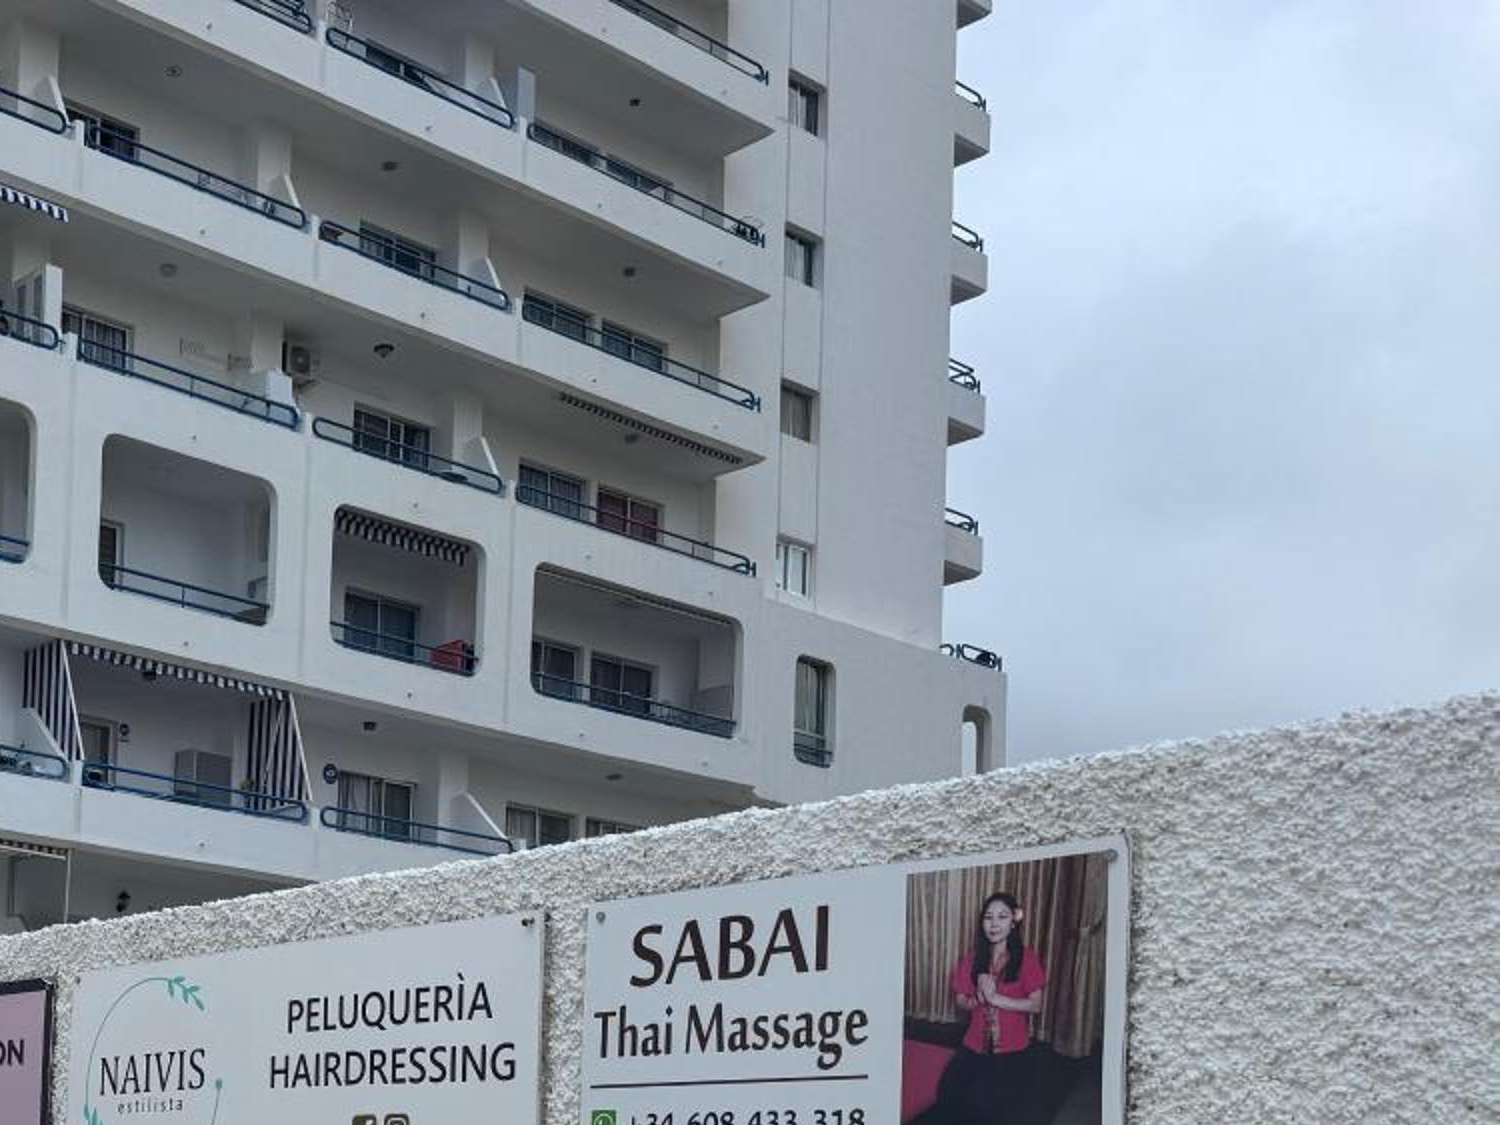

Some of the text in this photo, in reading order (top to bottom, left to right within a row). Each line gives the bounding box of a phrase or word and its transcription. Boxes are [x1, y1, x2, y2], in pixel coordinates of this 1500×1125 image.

[629, 904, 830, 988] SABAI
[594, 1003, 869, 1071] Thai Massage
[100, 1047, 205, 1096] NAIVIS
[269, 1042, 517, 1089] HAIRDRESSING
[117, 1098, 184, 1114] estilista
